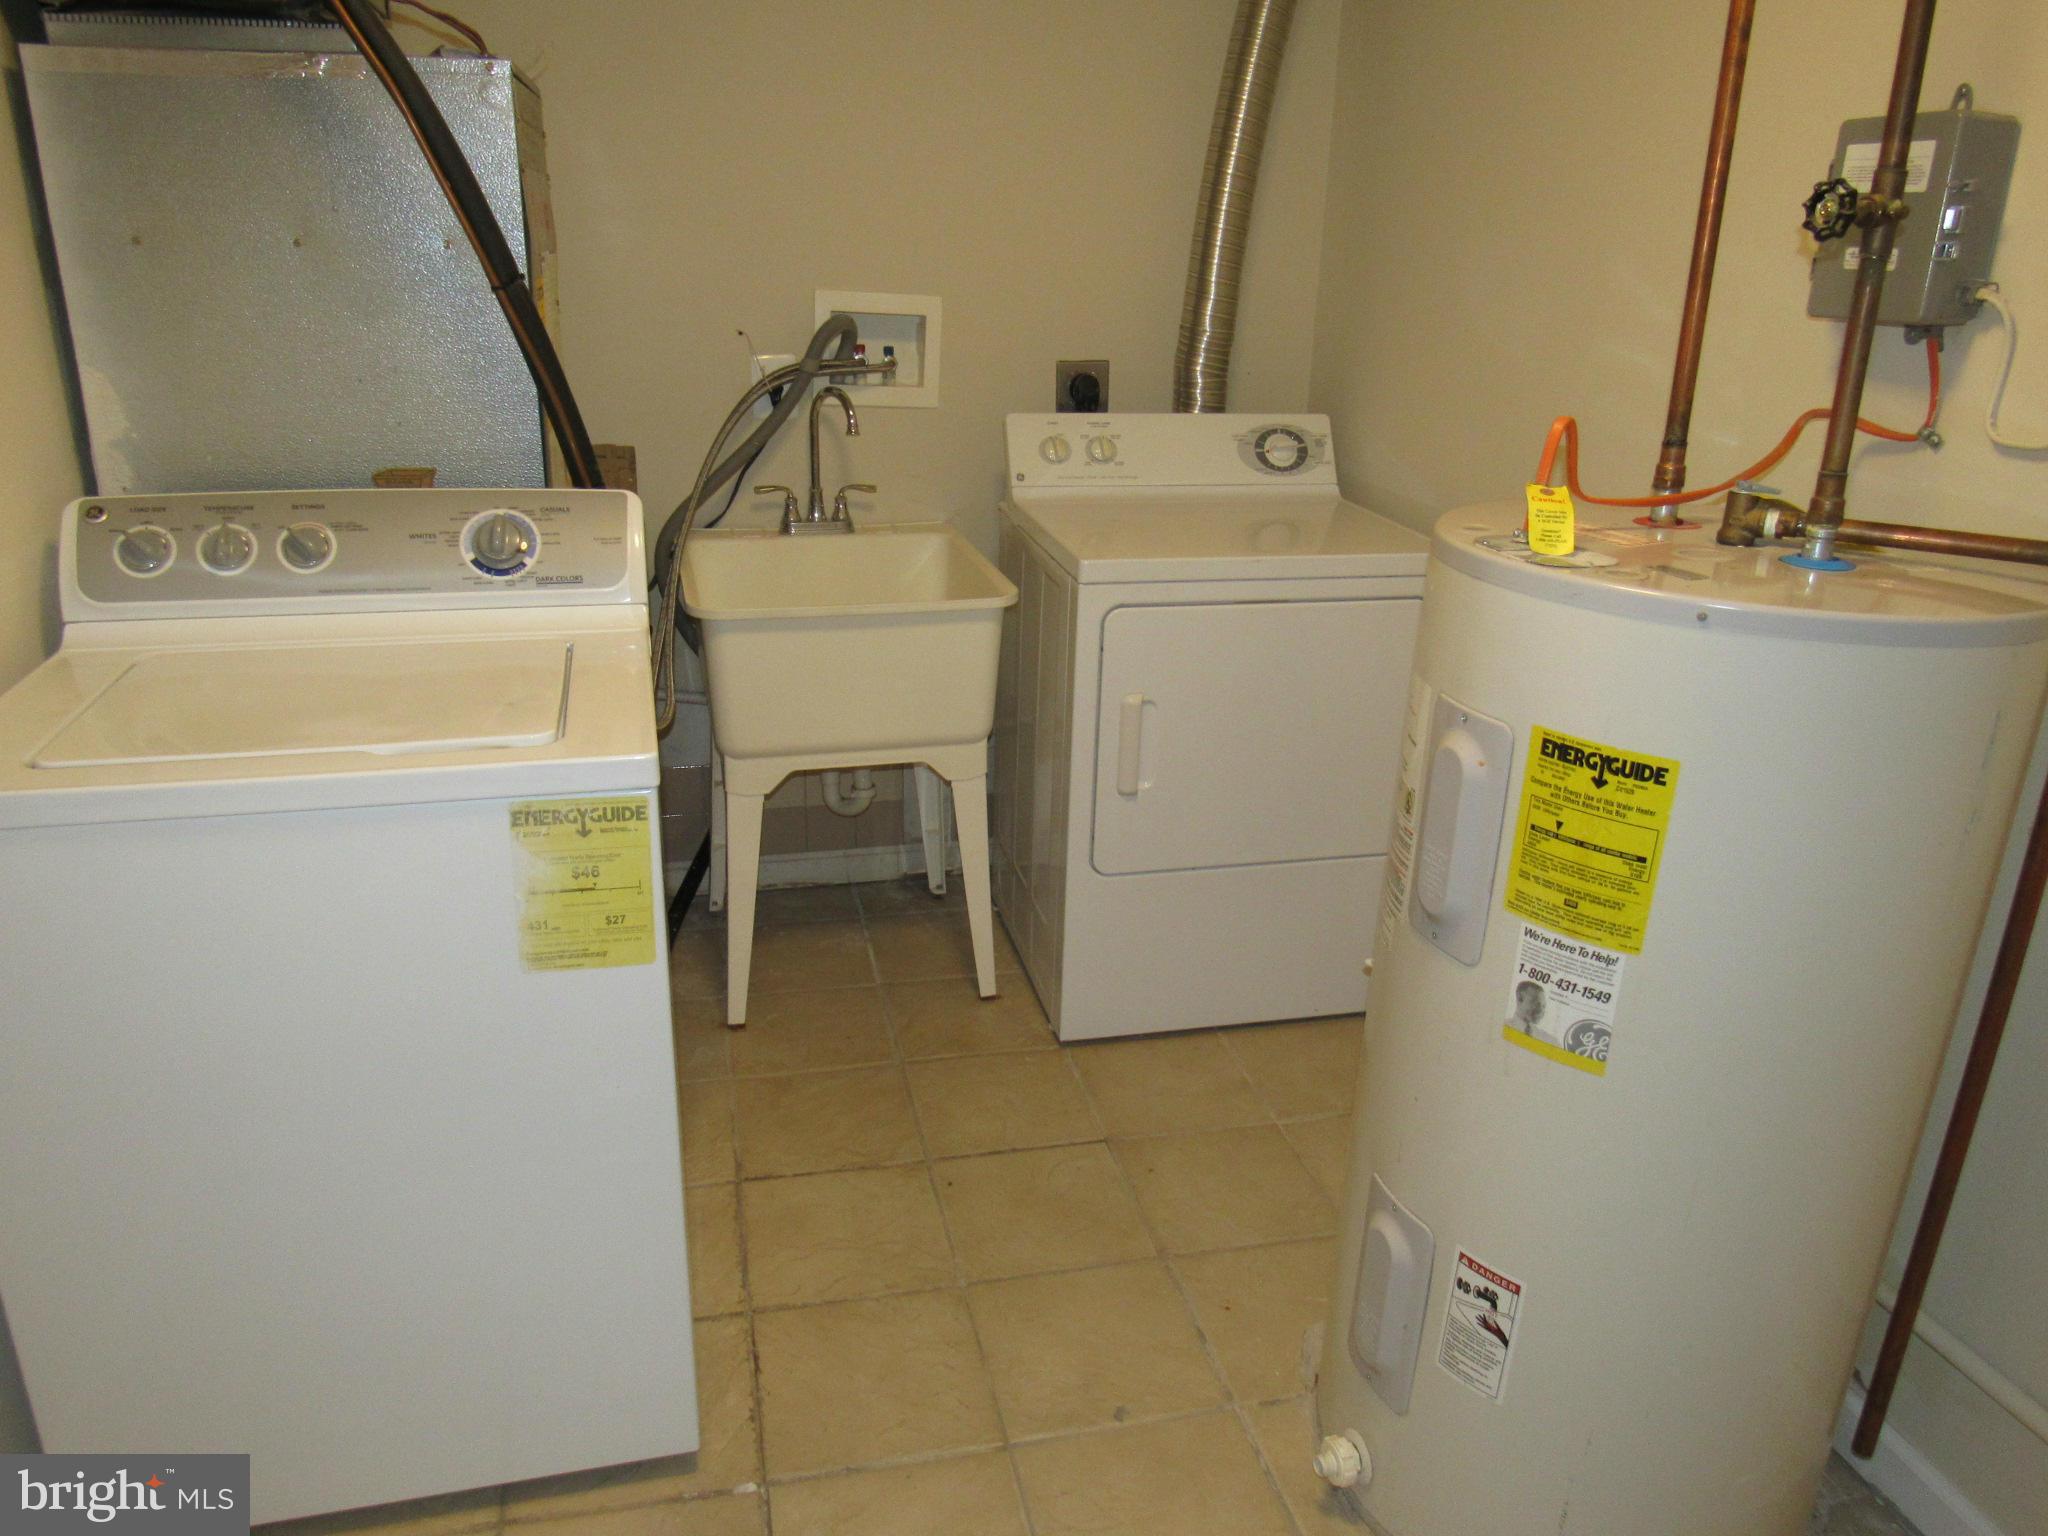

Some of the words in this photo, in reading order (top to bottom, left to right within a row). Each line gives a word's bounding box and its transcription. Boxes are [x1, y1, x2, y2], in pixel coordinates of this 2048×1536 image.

[1540, 737, 1669, 787] ENERGYGUIDE
[511, 805, 648, 828] ENERGYGUIDE
[1563, 786, 1584, 800] Energy
[1584, 791, 1595, 801] Use
[1615, 801, 1634, 812] Water
[1635, 806, 1656, 817] Heater
[571, 865, 600, 880] $46
[605, 914, 626, 926] $27
[1523, 926, 1552, 945] We're
[1552, 938, 1577, 955] Here
[1578, 946, 1590, 958] To
[1590, 950, 1620, 968] Help!
[1518, 963, 1612, 1005] 1-800-431-1549
[1471, 1262, 1517, 1293] DANGER
